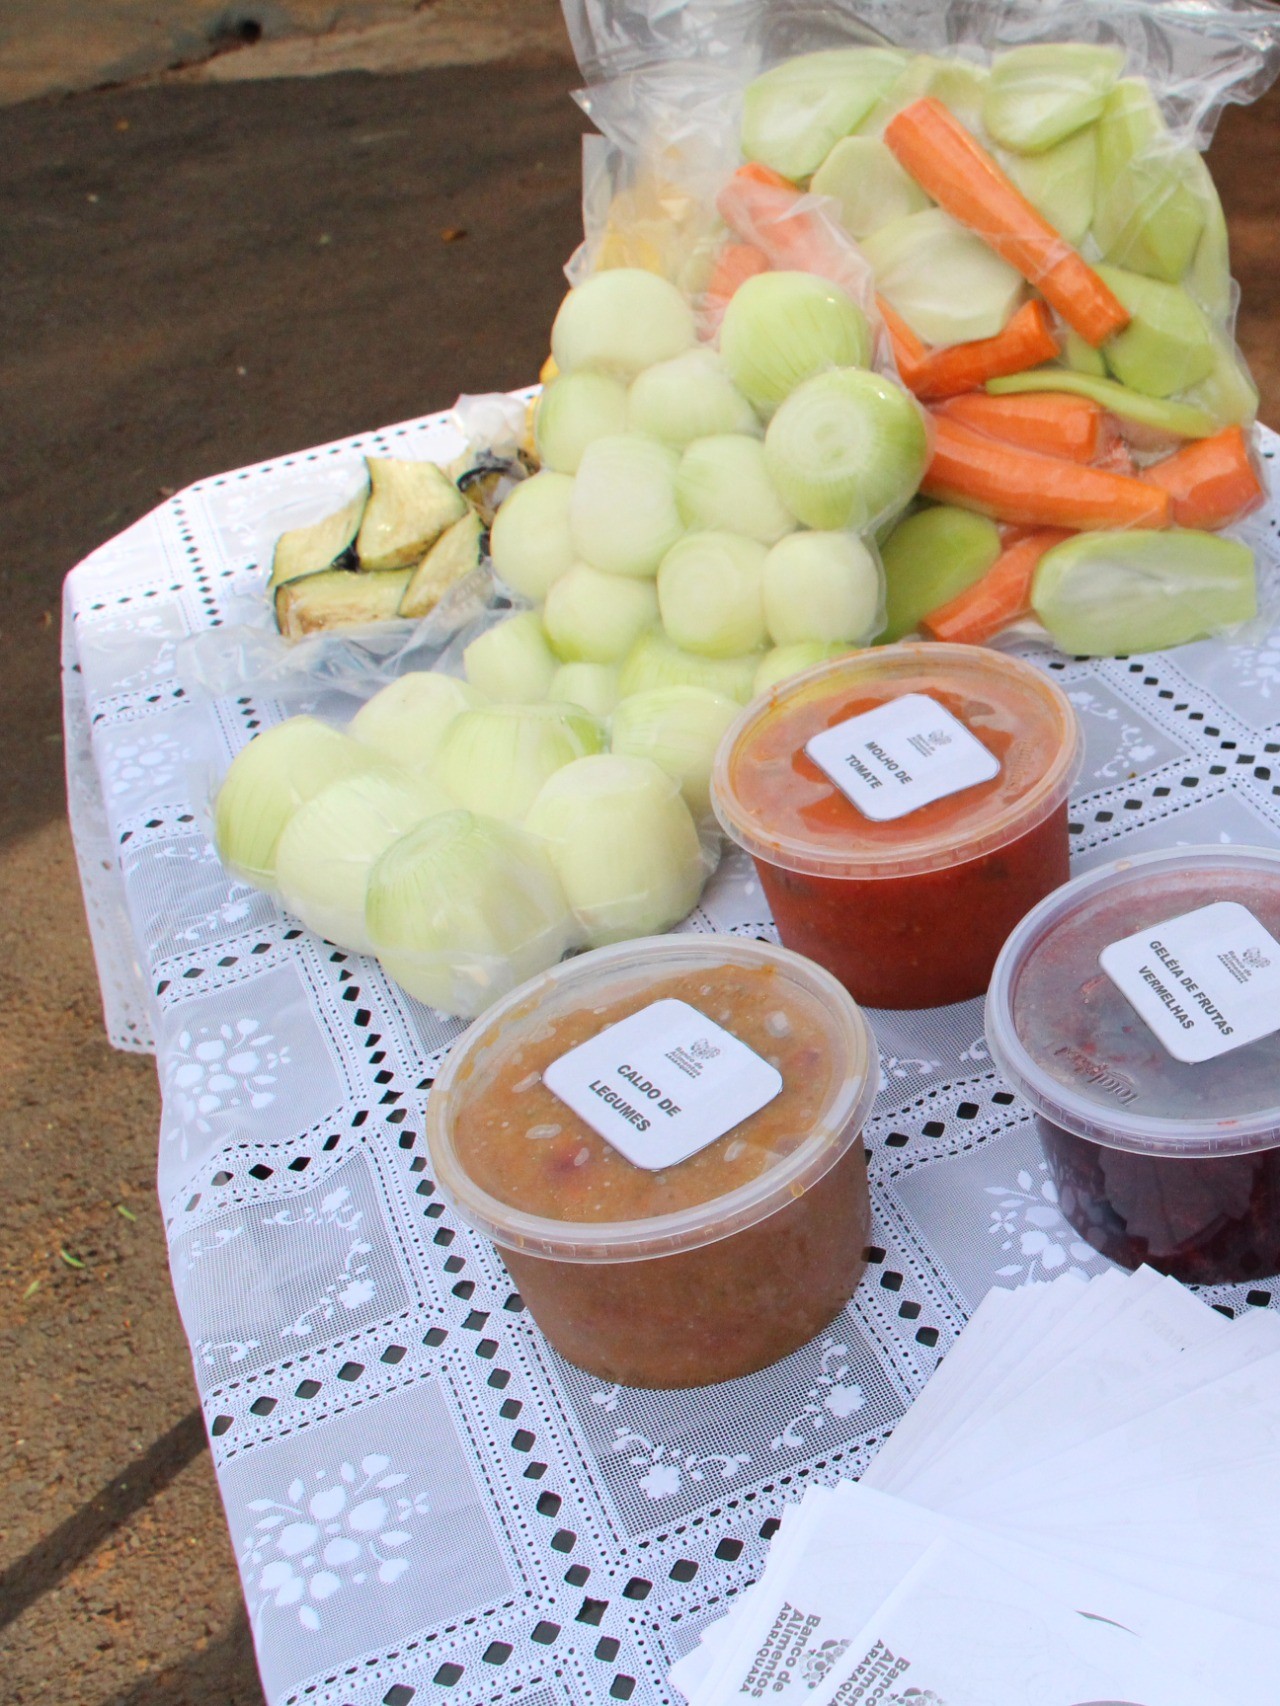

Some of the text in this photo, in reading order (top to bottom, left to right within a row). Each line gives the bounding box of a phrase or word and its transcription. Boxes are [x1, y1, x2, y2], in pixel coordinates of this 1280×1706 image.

[845, 754, 883, 790] TOMATE
[864, 741, 899, 772] MOLHO
[895, 770, 913, 784] DE
[1138, 965, 1195, 1030] VERMELHAS
[1180, 976, 1198, 993] DE
[1193, 991, 1234, 1036] FRUTAS
[588, 1079, 652, 1132] LEGUMES
[617, 1064, 682, 1117] CALDO DE
[739, 1601, 793, 1693] ARARAQUARA
[751, 1608, 805, 1699] Alimentos
[772, 1613, 822, 1693] Banco de
